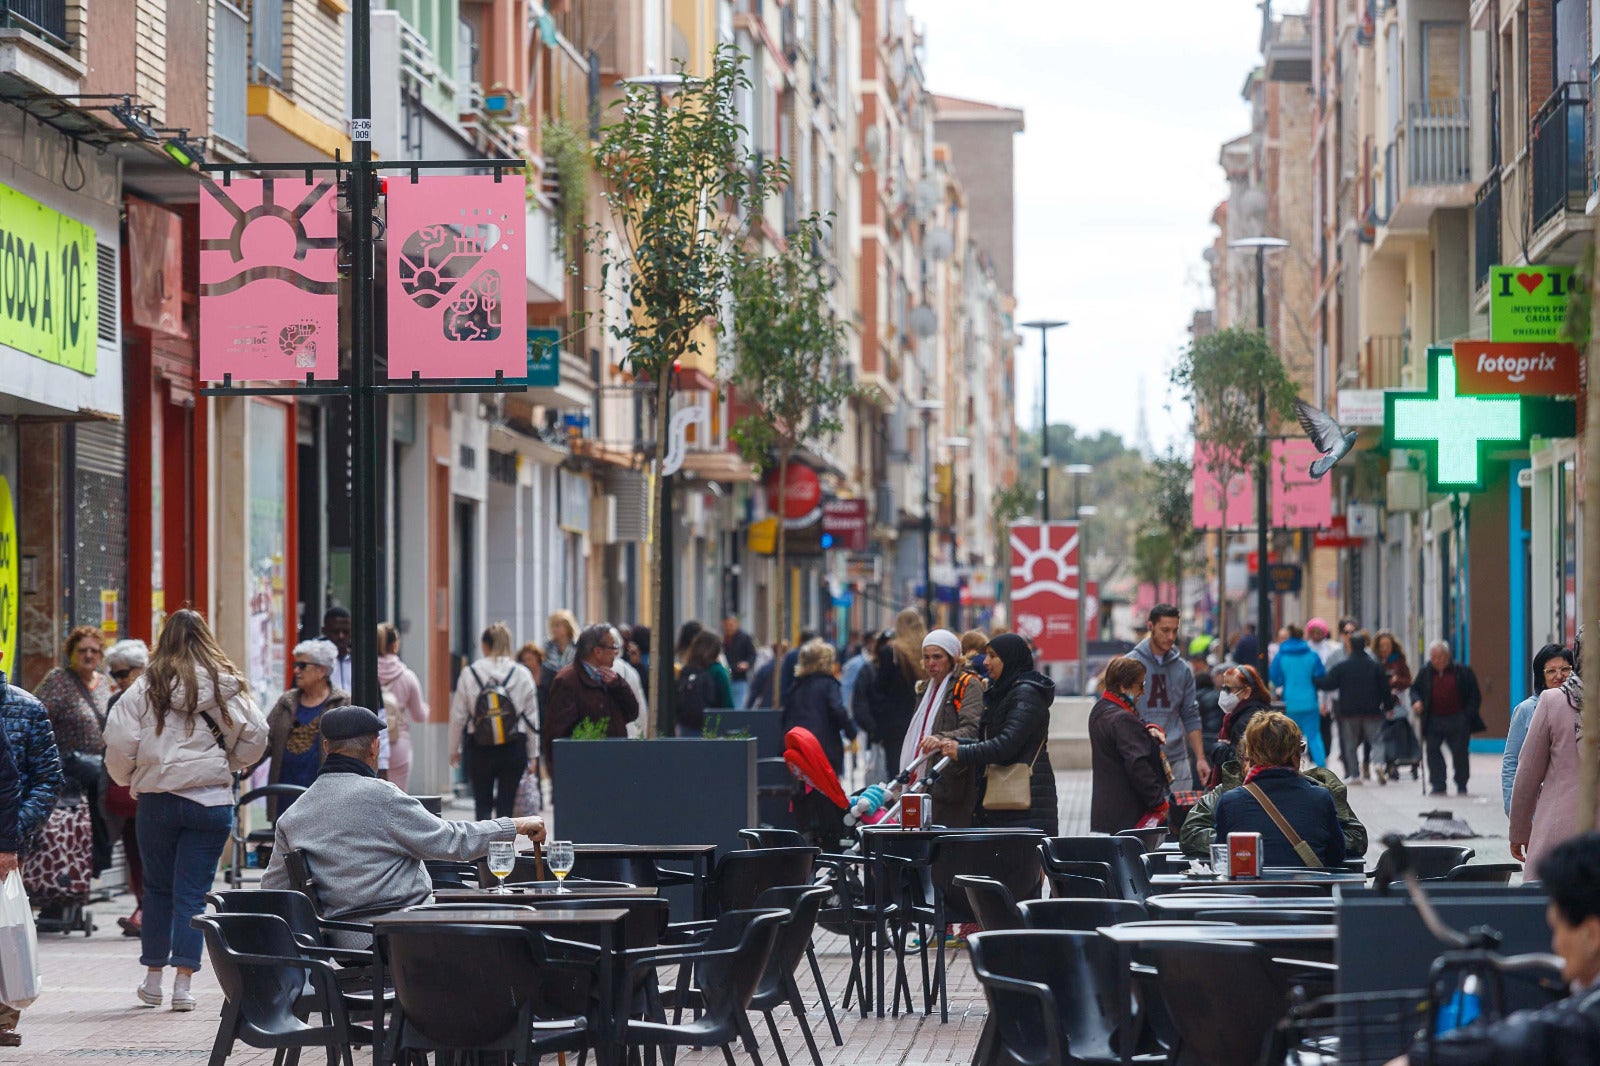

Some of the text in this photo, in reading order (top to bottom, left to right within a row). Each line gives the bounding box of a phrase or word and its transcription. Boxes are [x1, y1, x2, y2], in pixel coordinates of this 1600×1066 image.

[355, 131, 369, 139] 009
[41, 250, 53, 335] A
[1498, 273, 1514, 297] I
[1476, 351, 1557, 376] fotoprix
[1147, 674, 1171, 708] A
